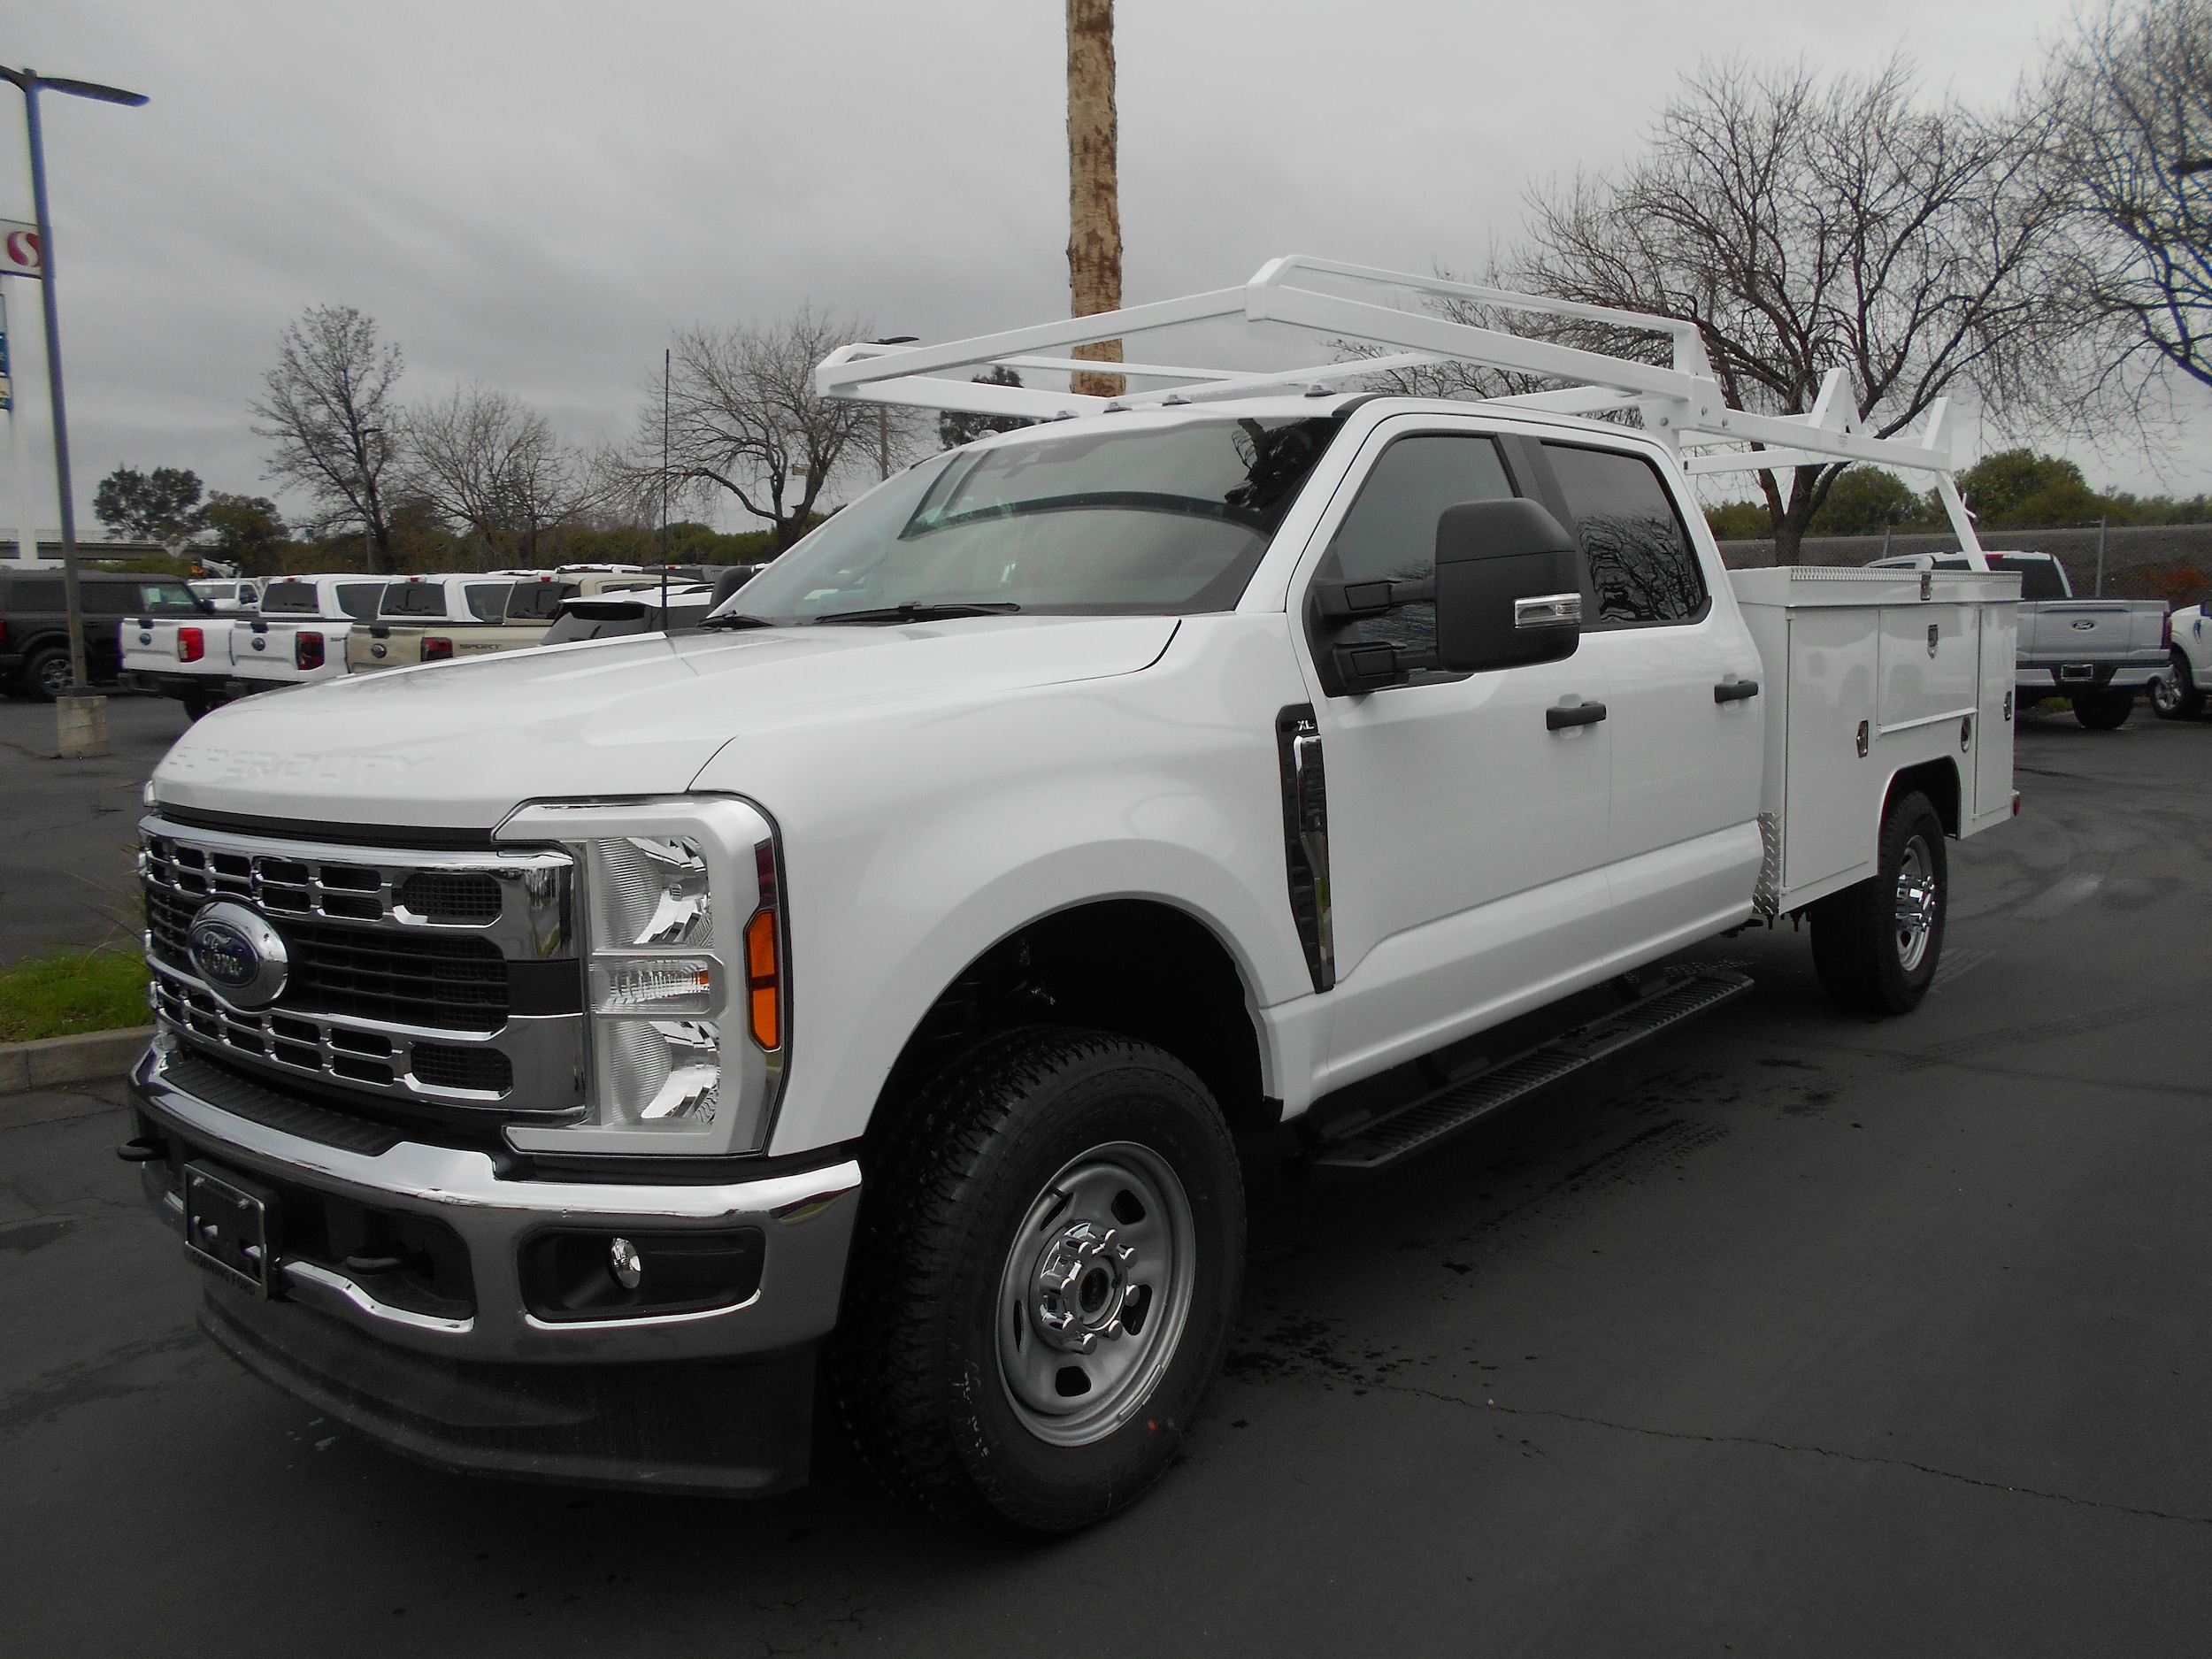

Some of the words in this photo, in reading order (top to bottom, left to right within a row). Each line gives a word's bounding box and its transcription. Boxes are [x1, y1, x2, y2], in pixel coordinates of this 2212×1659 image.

[1297, 719, 1315, 731] XL
[168, 746, 276, 779] SUPER
[279, 754, 434, 783] DUTY
[201, 931, 243, 977] Ford
